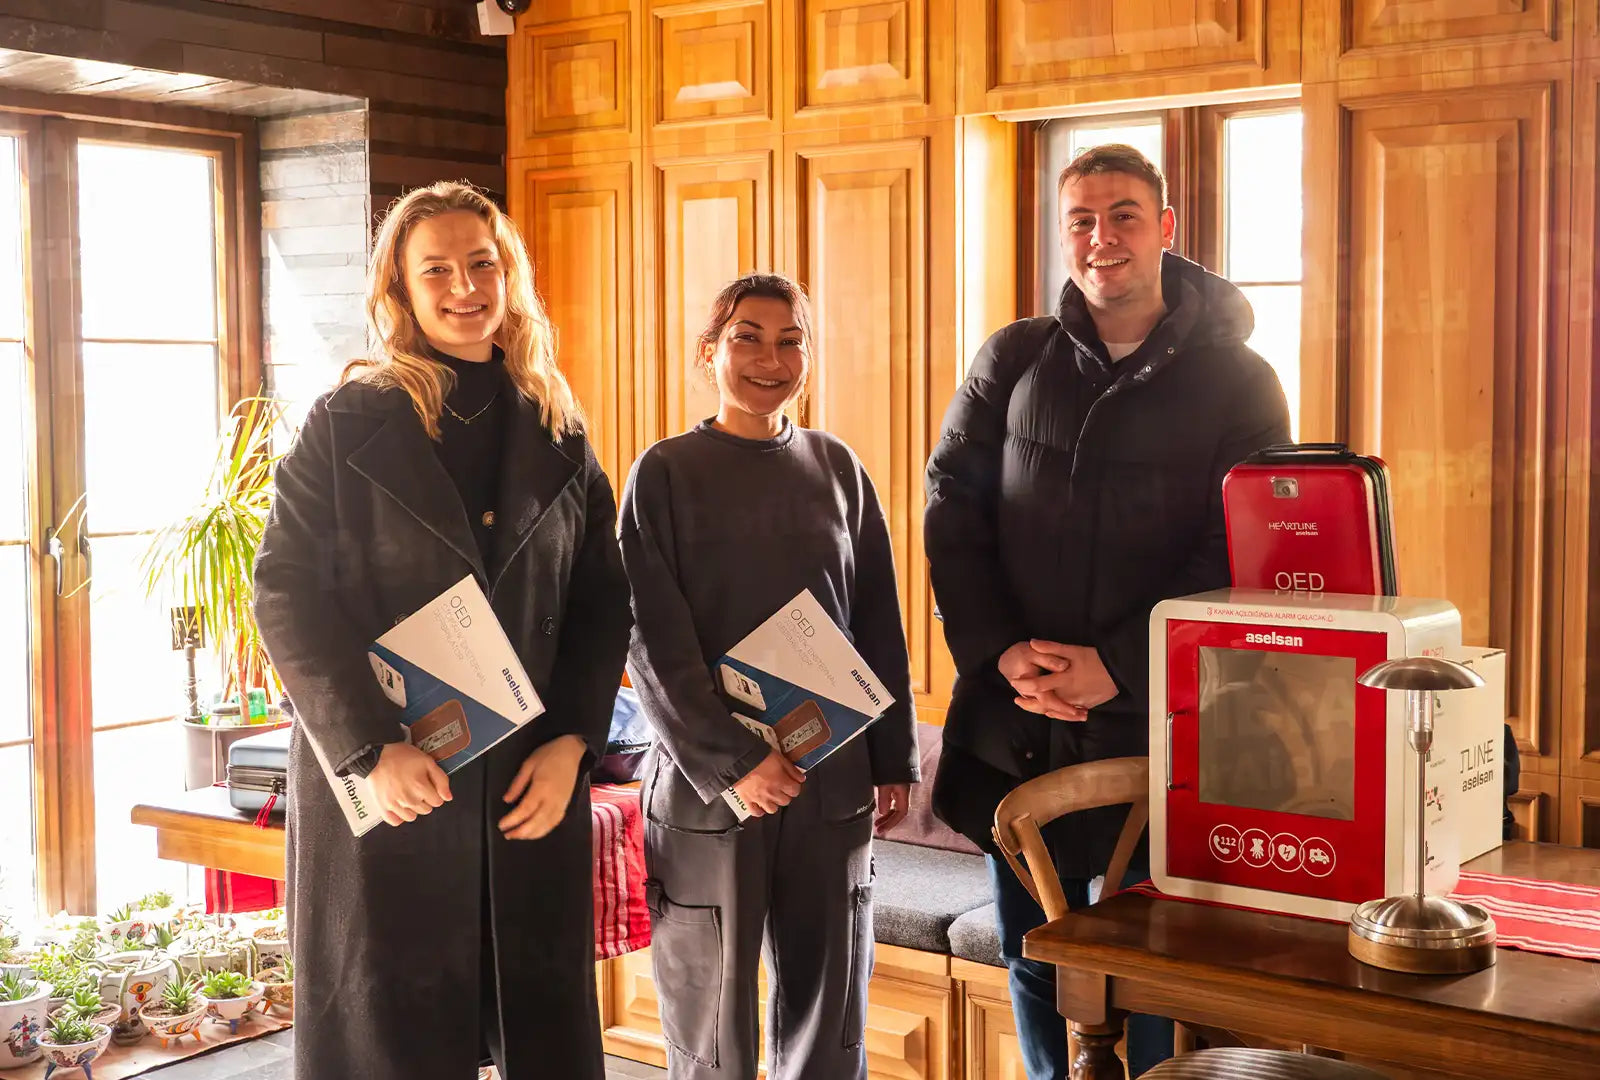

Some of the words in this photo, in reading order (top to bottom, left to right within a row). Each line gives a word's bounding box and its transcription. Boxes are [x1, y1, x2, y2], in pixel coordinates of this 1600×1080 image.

[1268, 520, 1318, 531] HEARTLINE
[1275, 571, 1325, 591] OED
[450, 595, 472, 629] OED
[790, 608, 815, 638] OED
[1245, 631, 1304, 647] aselsan
[502, 667, 529, 711] aselsan
[850, 668, 881, 706] aselsan
[1462, 769, 1494, 793] aselsan
[1220, 836, 1237, 847] 112
